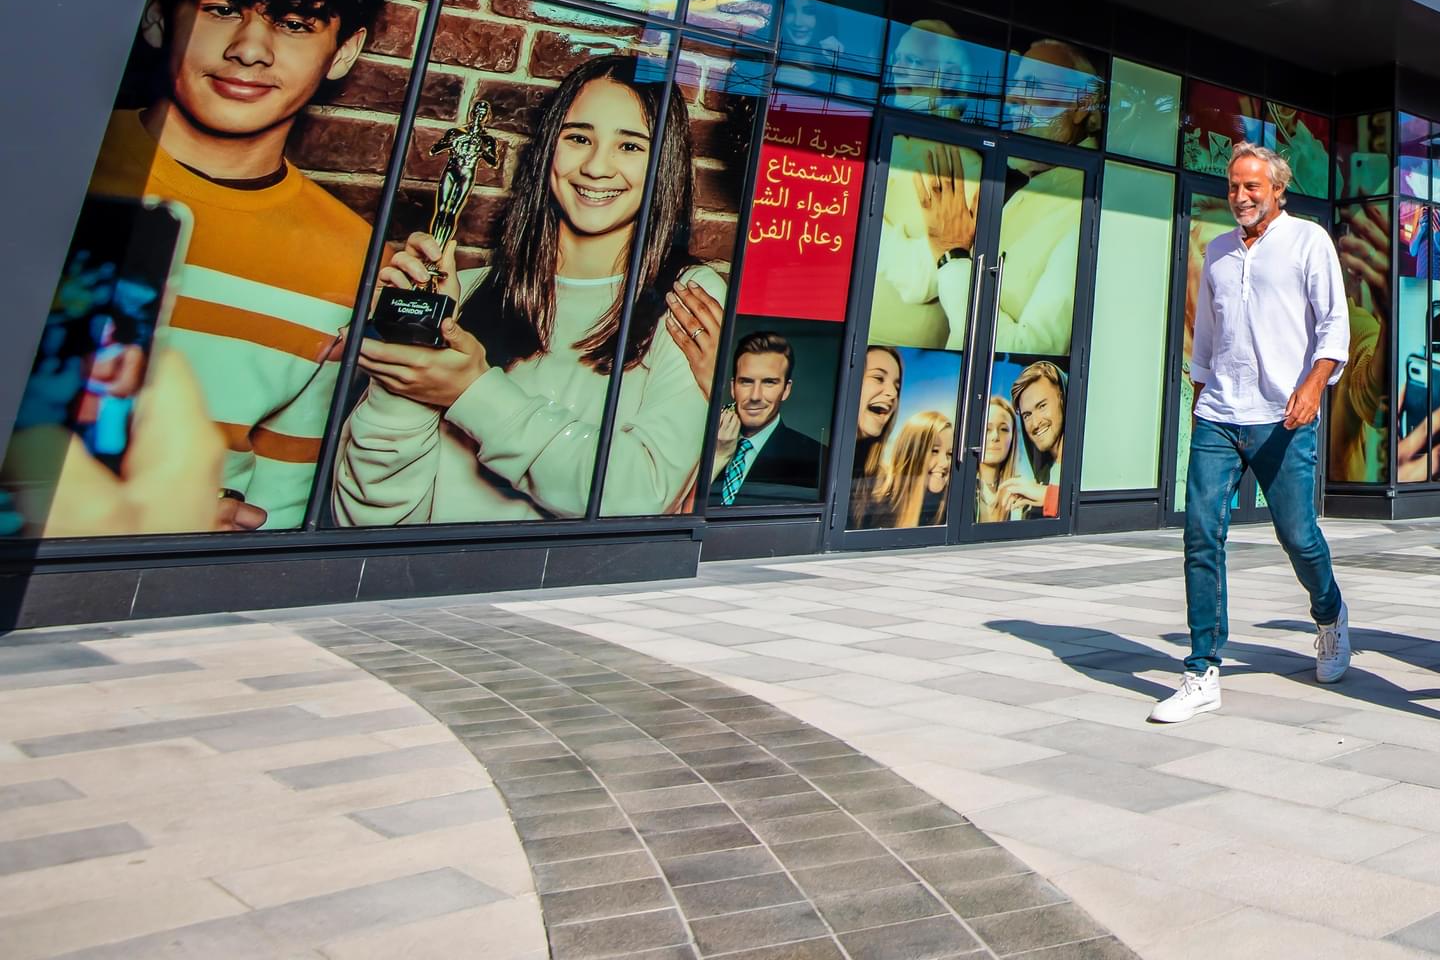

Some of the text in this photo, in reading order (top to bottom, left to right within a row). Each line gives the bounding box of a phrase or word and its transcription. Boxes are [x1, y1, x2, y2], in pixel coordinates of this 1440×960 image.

[809, 128, 862, 160] تجربة
[766, 155, 852, 186] للاستمتاع
[796, 190, 849, 219] أضواء
[748, 218, 843, 255] وعالم الفن
